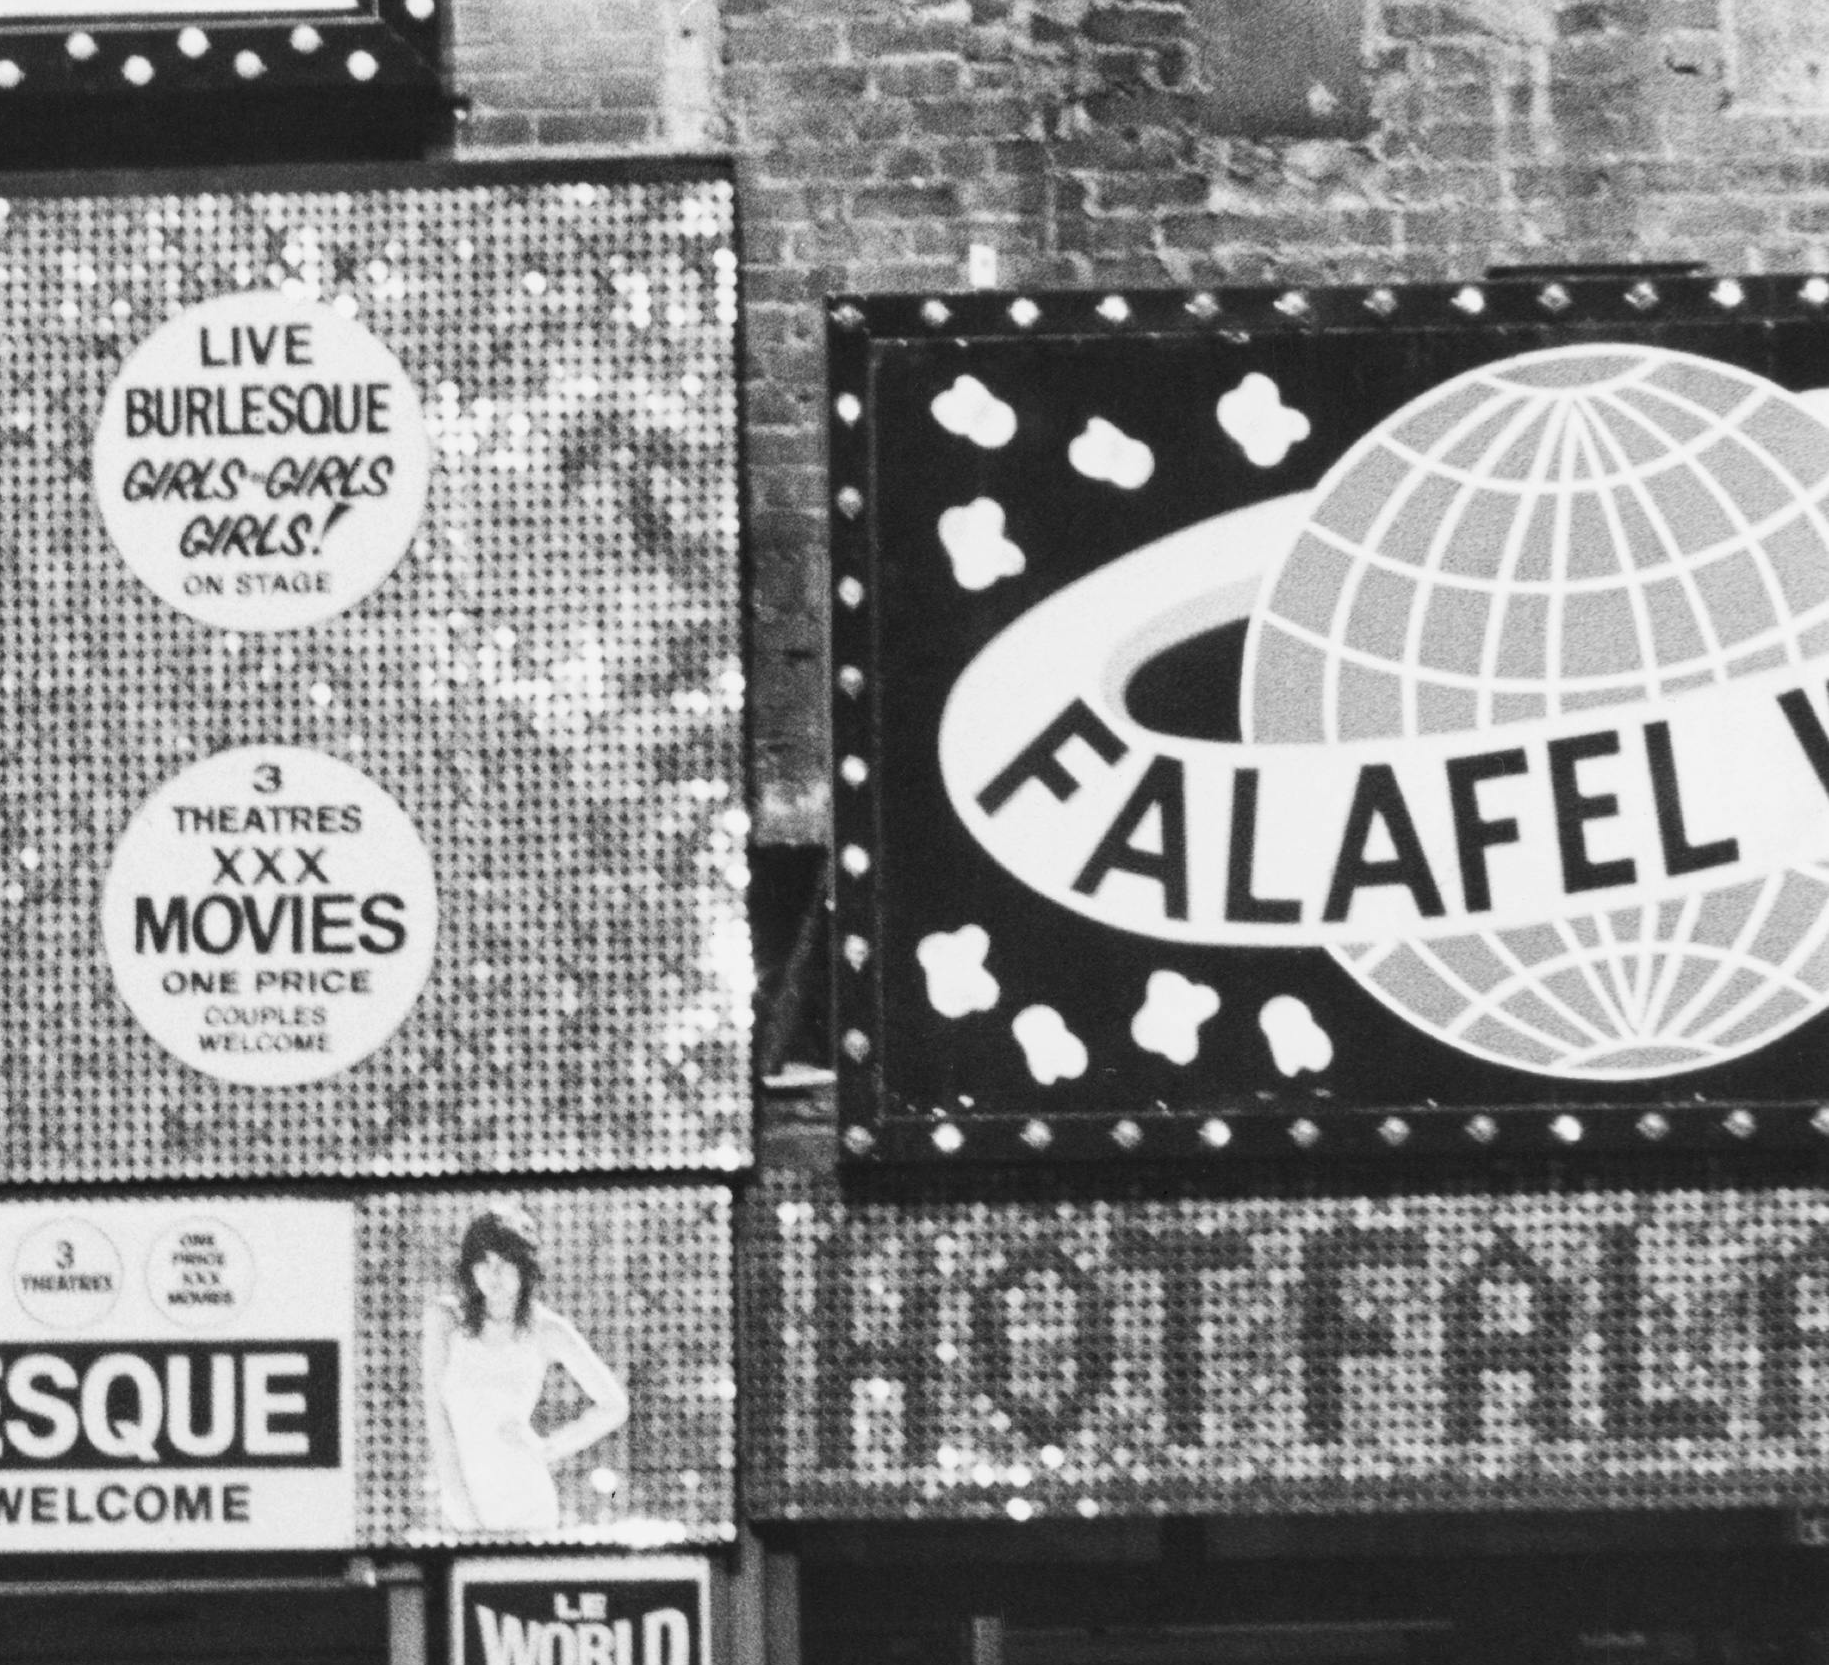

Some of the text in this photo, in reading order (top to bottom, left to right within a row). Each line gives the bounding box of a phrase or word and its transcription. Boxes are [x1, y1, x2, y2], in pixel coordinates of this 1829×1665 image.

[200, 324, 312, 368] LIVE
[125, 382, 390, 439] BURLESQUE
[179, 501, 354, 559] GIRLS!
[183, 572, 327, 596] ON STAGE
[253, 764, 283, 794] 3
[173, 804, 362, 834] THEATRES
[976, 697, 1742, 927] FALAFEL
[213, 847, 329, 885] XXX
[135, 893, 407, 956] MOVIES
[162, 969, 369, 995] ONE PRICE
[203, 1006, 327, 1027] COUPLES
[199, 1034, 326, 1052] WELCOME
[55, 1240, 75, 1271] 3
[818, 1235, 1252, 1465] HOT
[550, 1590, 610, 1620] LE
